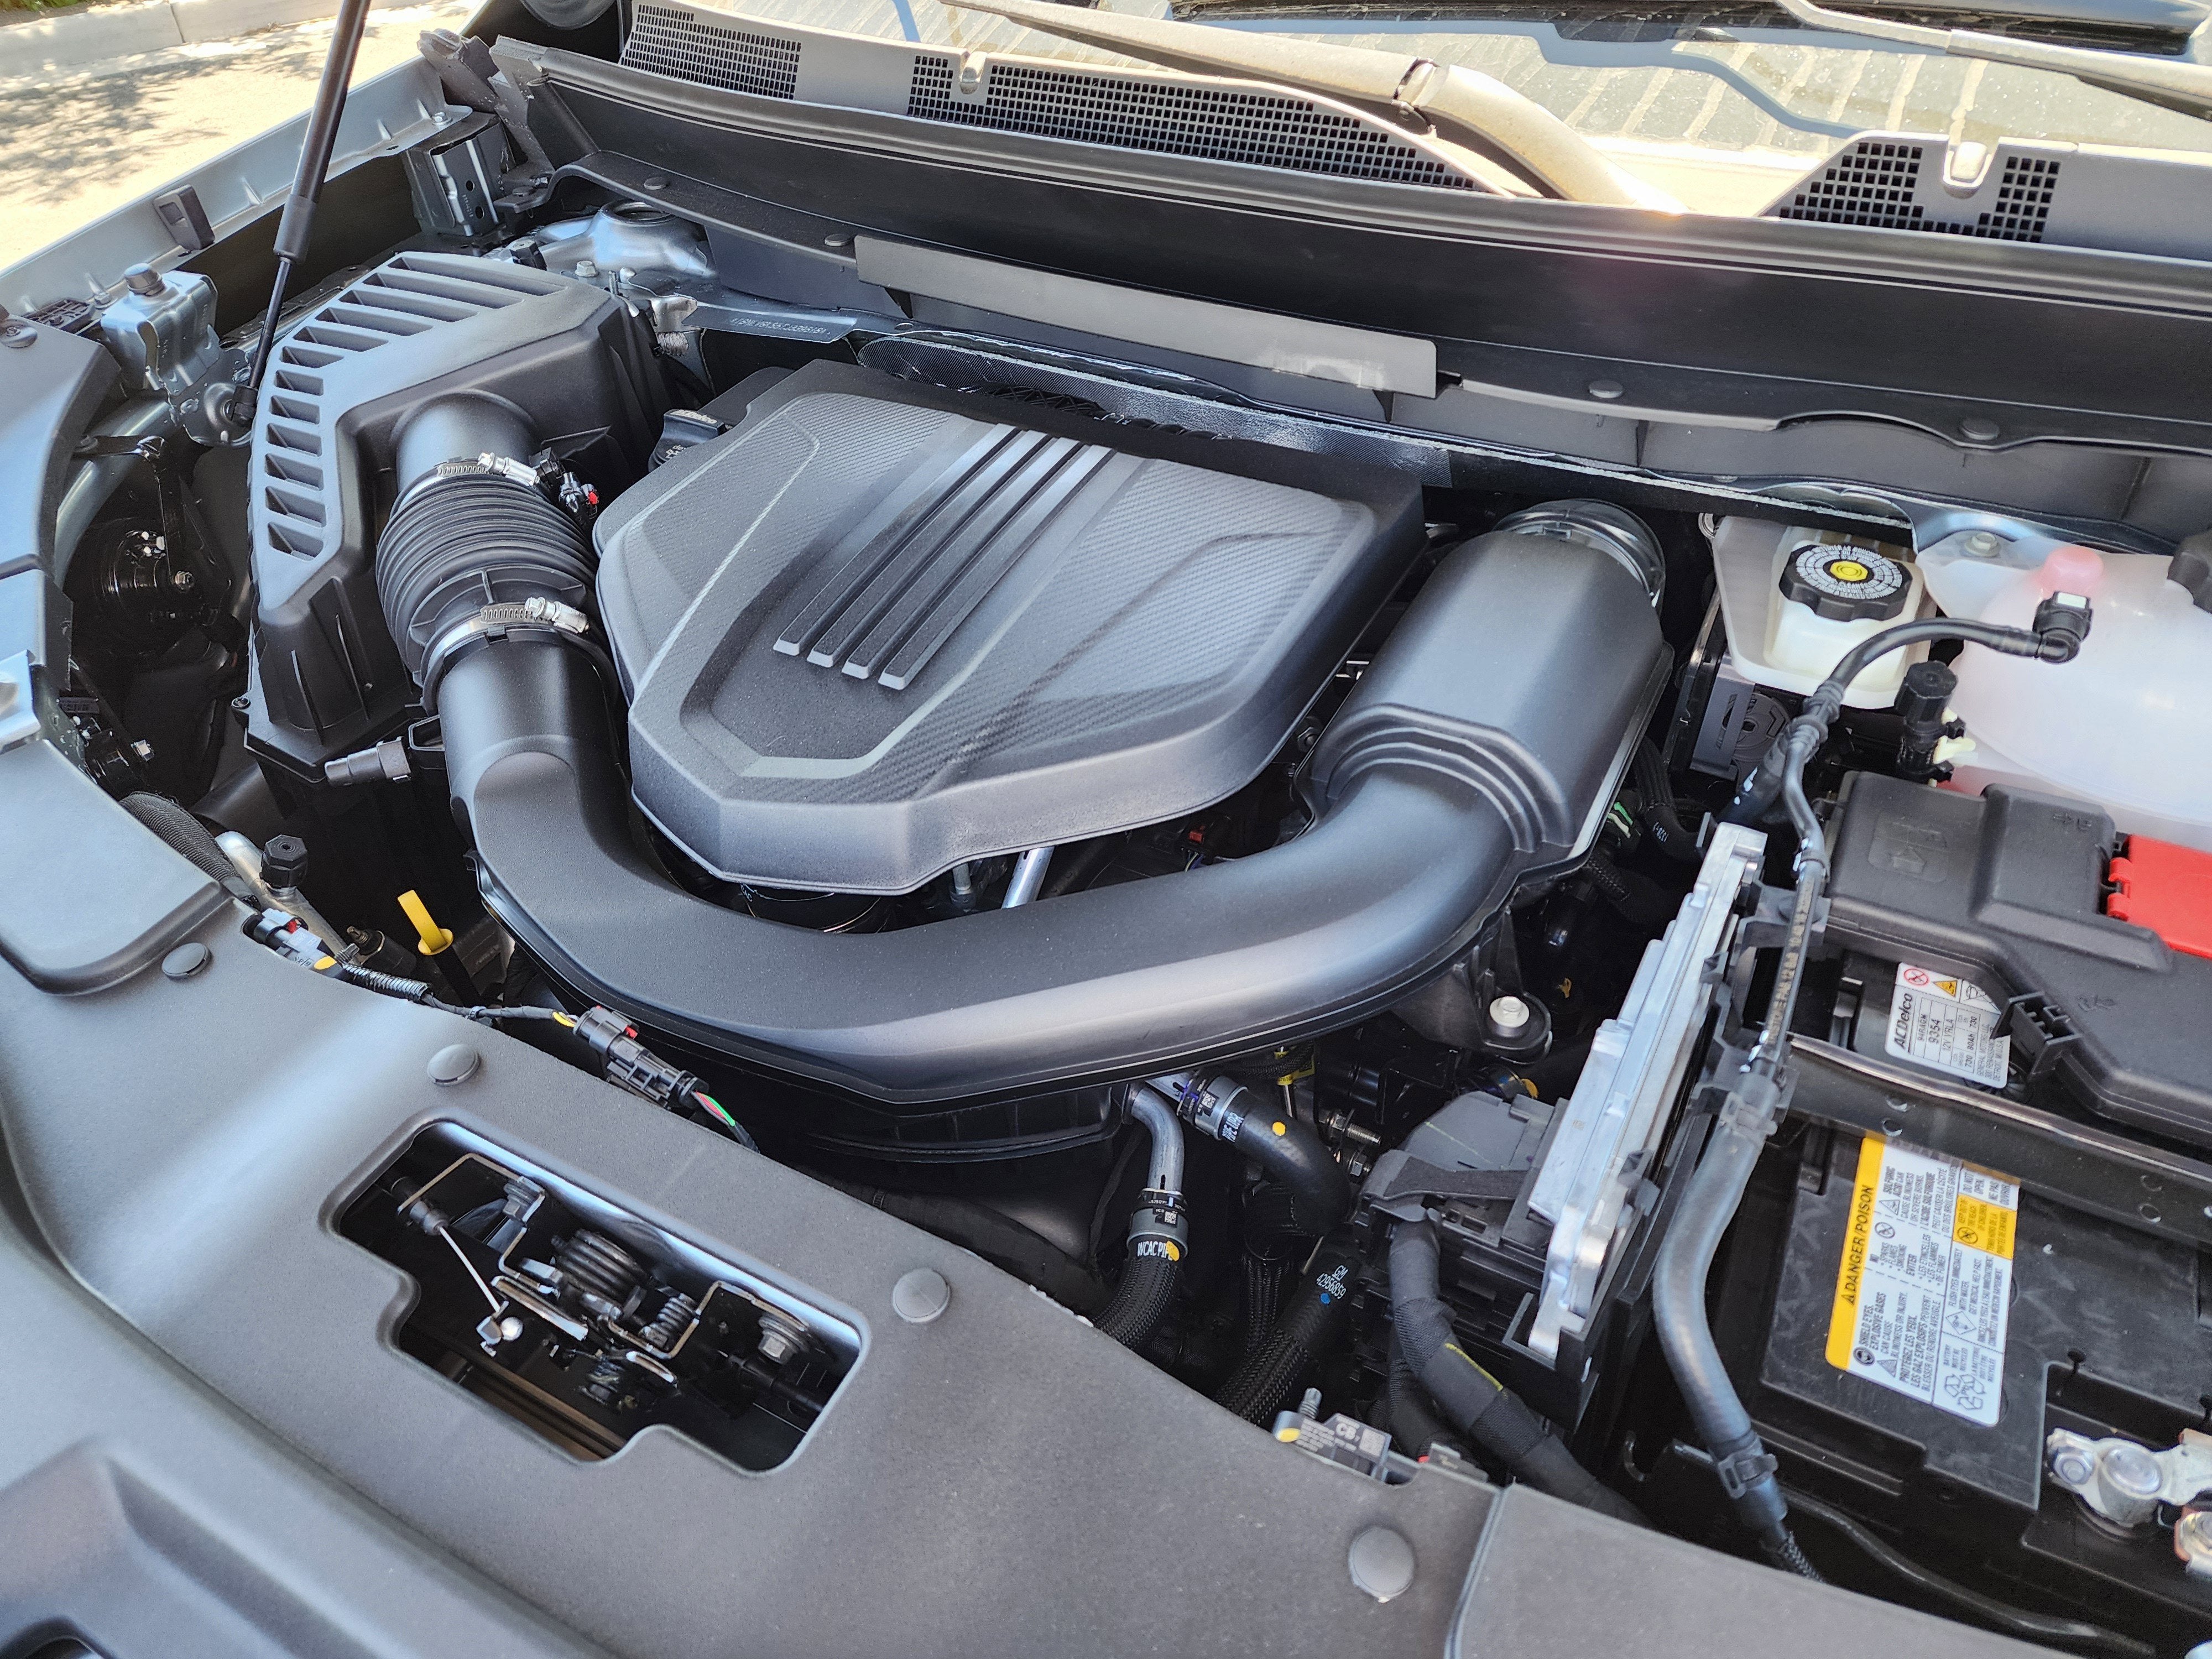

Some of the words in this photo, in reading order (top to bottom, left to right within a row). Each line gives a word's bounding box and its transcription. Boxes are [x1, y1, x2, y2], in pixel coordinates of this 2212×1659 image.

[1894, 993, 1912, 1048] ACDelco
[1917, 1013, 1927, 1040] 94RAGM
[1944, 1019, 1954, 1036] VRLA
[1928, 1018, 1940, 1043] 9354
[1942, 1039, 1951, 1051] 12V
[1979, 1033, 1988, 1053] MOTORS
[1964, 1055, 1973, 1067] 730
[1882, 1166, 1895, 1194] SULFURIC
[1895, 1171, 1904, 1183] CAN
[1963, 1171, 1974, 1185] NOT
[1892, 1182, 1902, 1197] ACID
[1903, 1172, 1914, 1201] BLINDNESS
[1962, 1183, 1973, 1193] DO
[1989, 1180, 1999, 1192] PAS
[1911, 1193, 1921, 1213] SEVERE
[1933, 1193, 1943, 1215] CAUSER
[1988, 1192, 1998, 1201] NE
[1900, 1201, 1910, 1218] CAUSE
[1910, 1213, 1918, 1222] OR
[1931, 1214, 1940, 1229] PEUT
[1942, 1213, 1951, 1224] DES
[1941, 1224, 1950, 1233] OU
[1845, 1185, 1872, 1292] DANGER/POISON
[1138, 1241, 1158, 1256] WCAC
[1887, 1244, 1898, 1265] FLAMES
[1918, 1265, 1927, 1276] LES
[1936, 1254, 1945, 1274] FUMER
[1334, 1265, 1349, 1281] GM
[1927, 1267, 1936, 1280] LES
[1935, 1274, 1944, 1282] DE
[1316, 1273, 1347, 1299] 42956859
[1950, 1278, 1959, 1291] EYES
[1874, 1292, 1886, 1313] GASES
[1919, 1295, 1931, 1322] PEUVENT
[1895, 1313, 1904, 1324] OR
[1859, 1322, 1870, 1346] SHIELD
[1869, 1313, 1882, 1350] EXPLOSIVE
[1882, 1320, 1892, 1340] CAUSE
[1880, 1340, 1889, 1354] CAN
[1890, 1324, 1902, 1358] BLINDNESS
[1904, 1333, 1915, 1347] LES
[1914, 1322, 1927, 1359] EXPLOSIFS
[1926, 1327, 1937, 1352] RENDRE
[1899, 1347, 1912, 1383] PROTÉGEZ
[1924, 1352, 1934, 1363] OU
[1912, 1358, 1923, 1374] GAZ
[1910, 1373, 1921, 1387] LES
[1921, 1363, 1932, 1391] BLESSER
